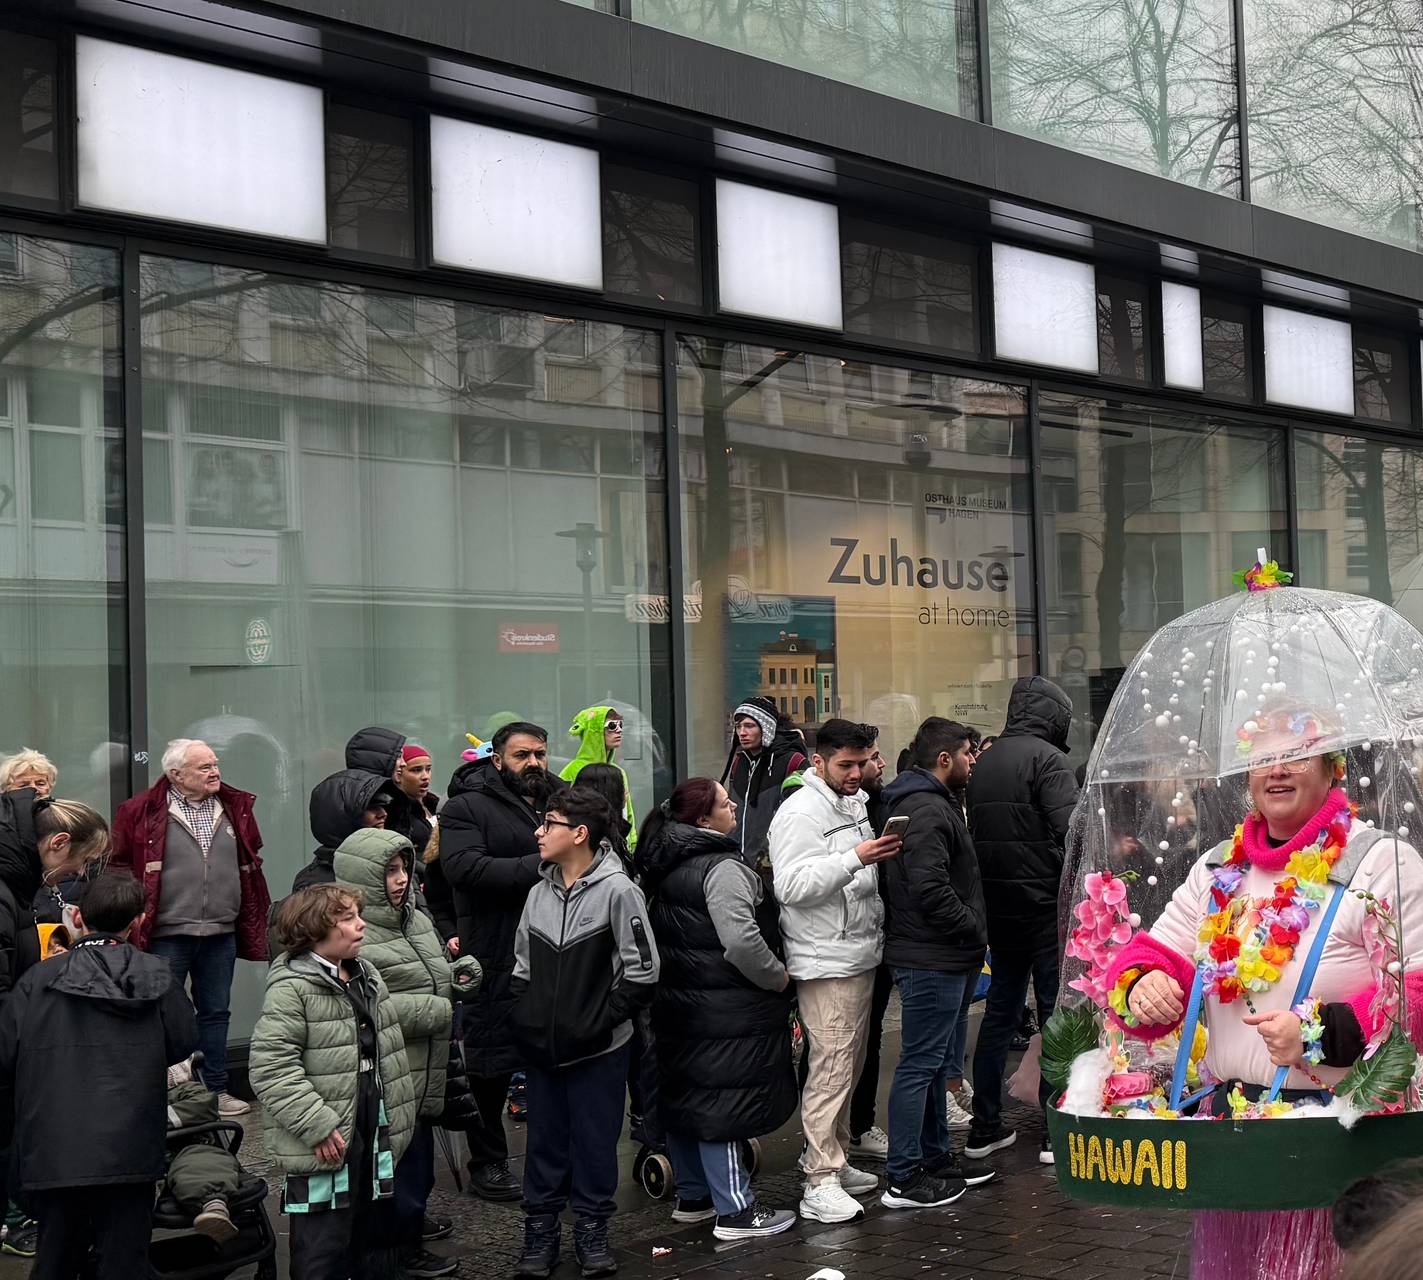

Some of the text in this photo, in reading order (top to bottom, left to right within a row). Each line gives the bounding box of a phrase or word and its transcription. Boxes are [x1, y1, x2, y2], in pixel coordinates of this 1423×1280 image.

[925, 493, 1007, 510] OSTHAUS MUSEUM
[948, 508, 979, 520] HAGEN
[828, 537, 1009, 592] Zuhause
[918, 596, 1010, 627] at home
[1068, 1132, 1187, 1190] HAWAII
